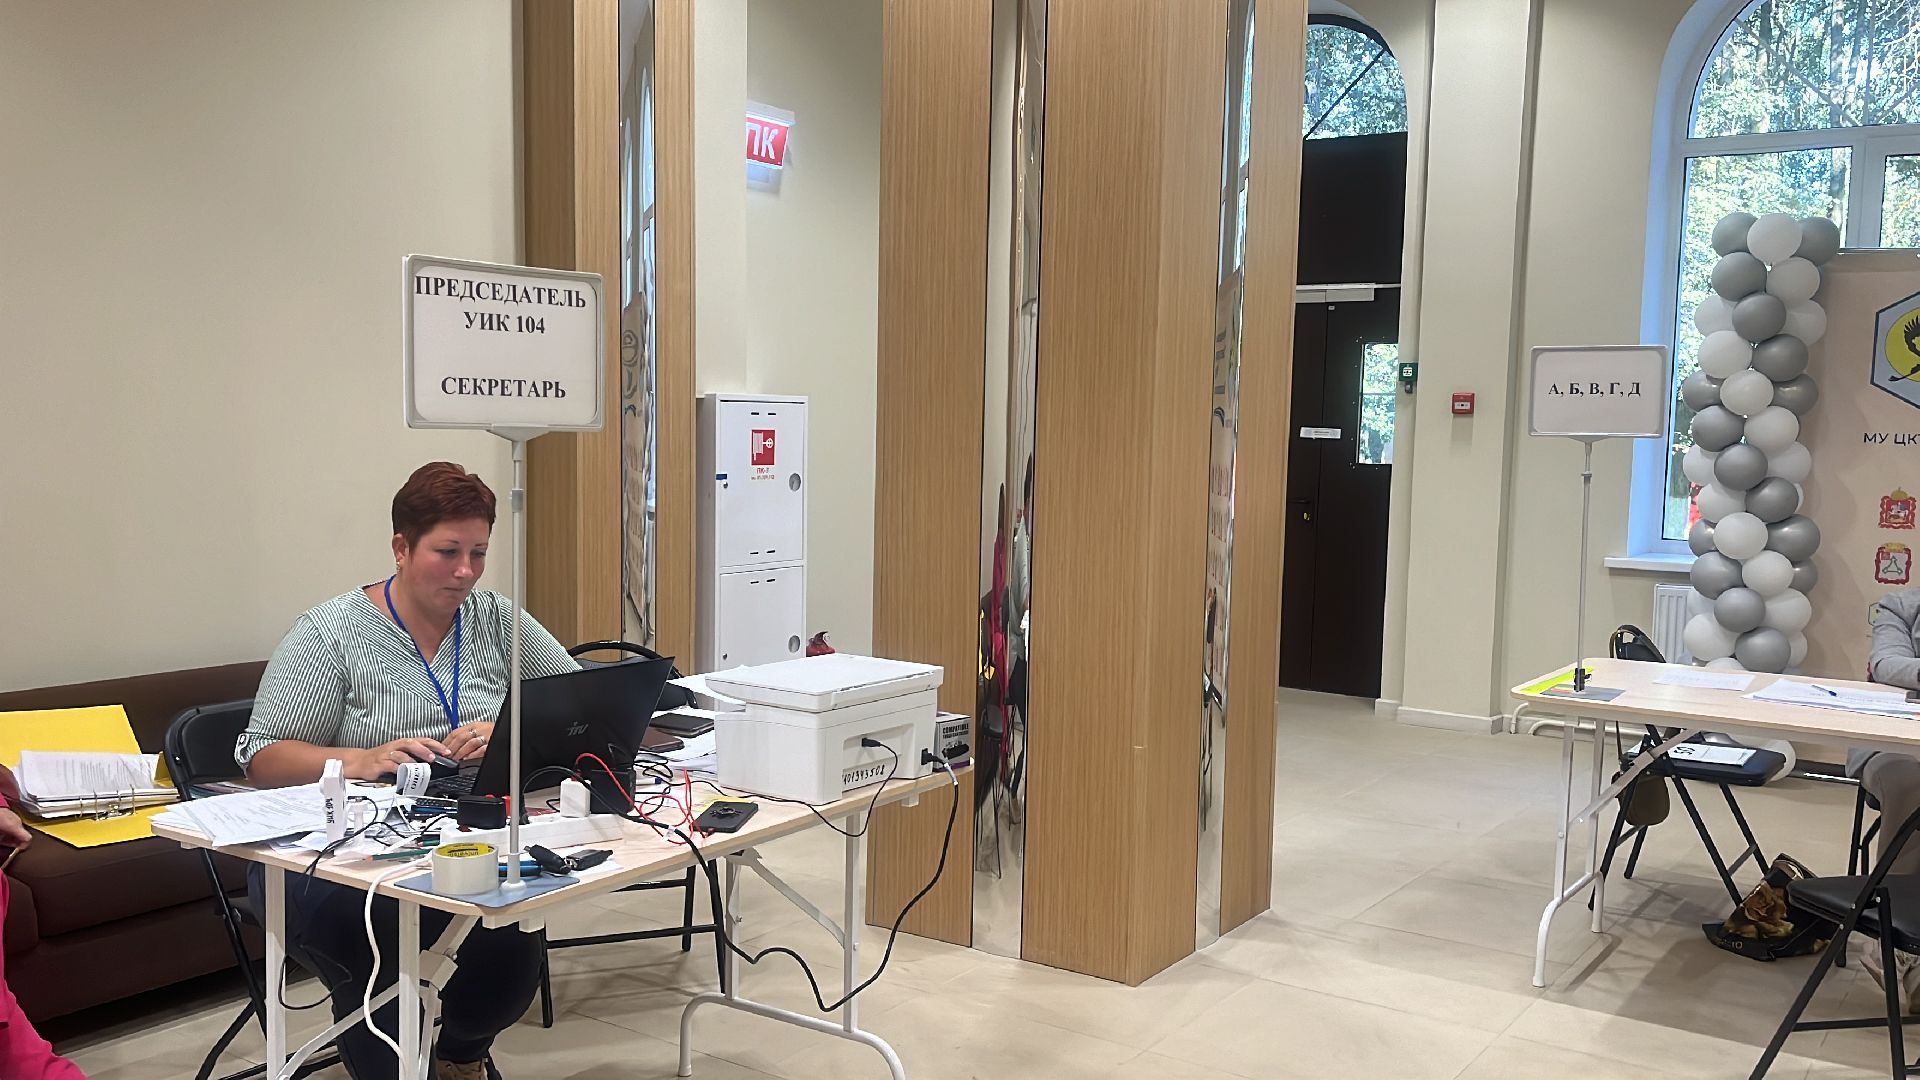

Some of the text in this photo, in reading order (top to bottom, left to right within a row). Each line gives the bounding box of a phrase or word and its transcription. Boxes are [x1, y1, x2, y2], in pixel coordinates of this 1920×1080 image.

[415, 275, 587, 308] ПРЕДСЕДАТЕЛЬ
[463, 311, 545, 334] УИК 104
[441, 376, 566, 399] СЕКРЕТАРЬ
[1548, 382, 1641, 397] А, Б, В, Г, Д
[1863, 432, 1889, 444] МУ
